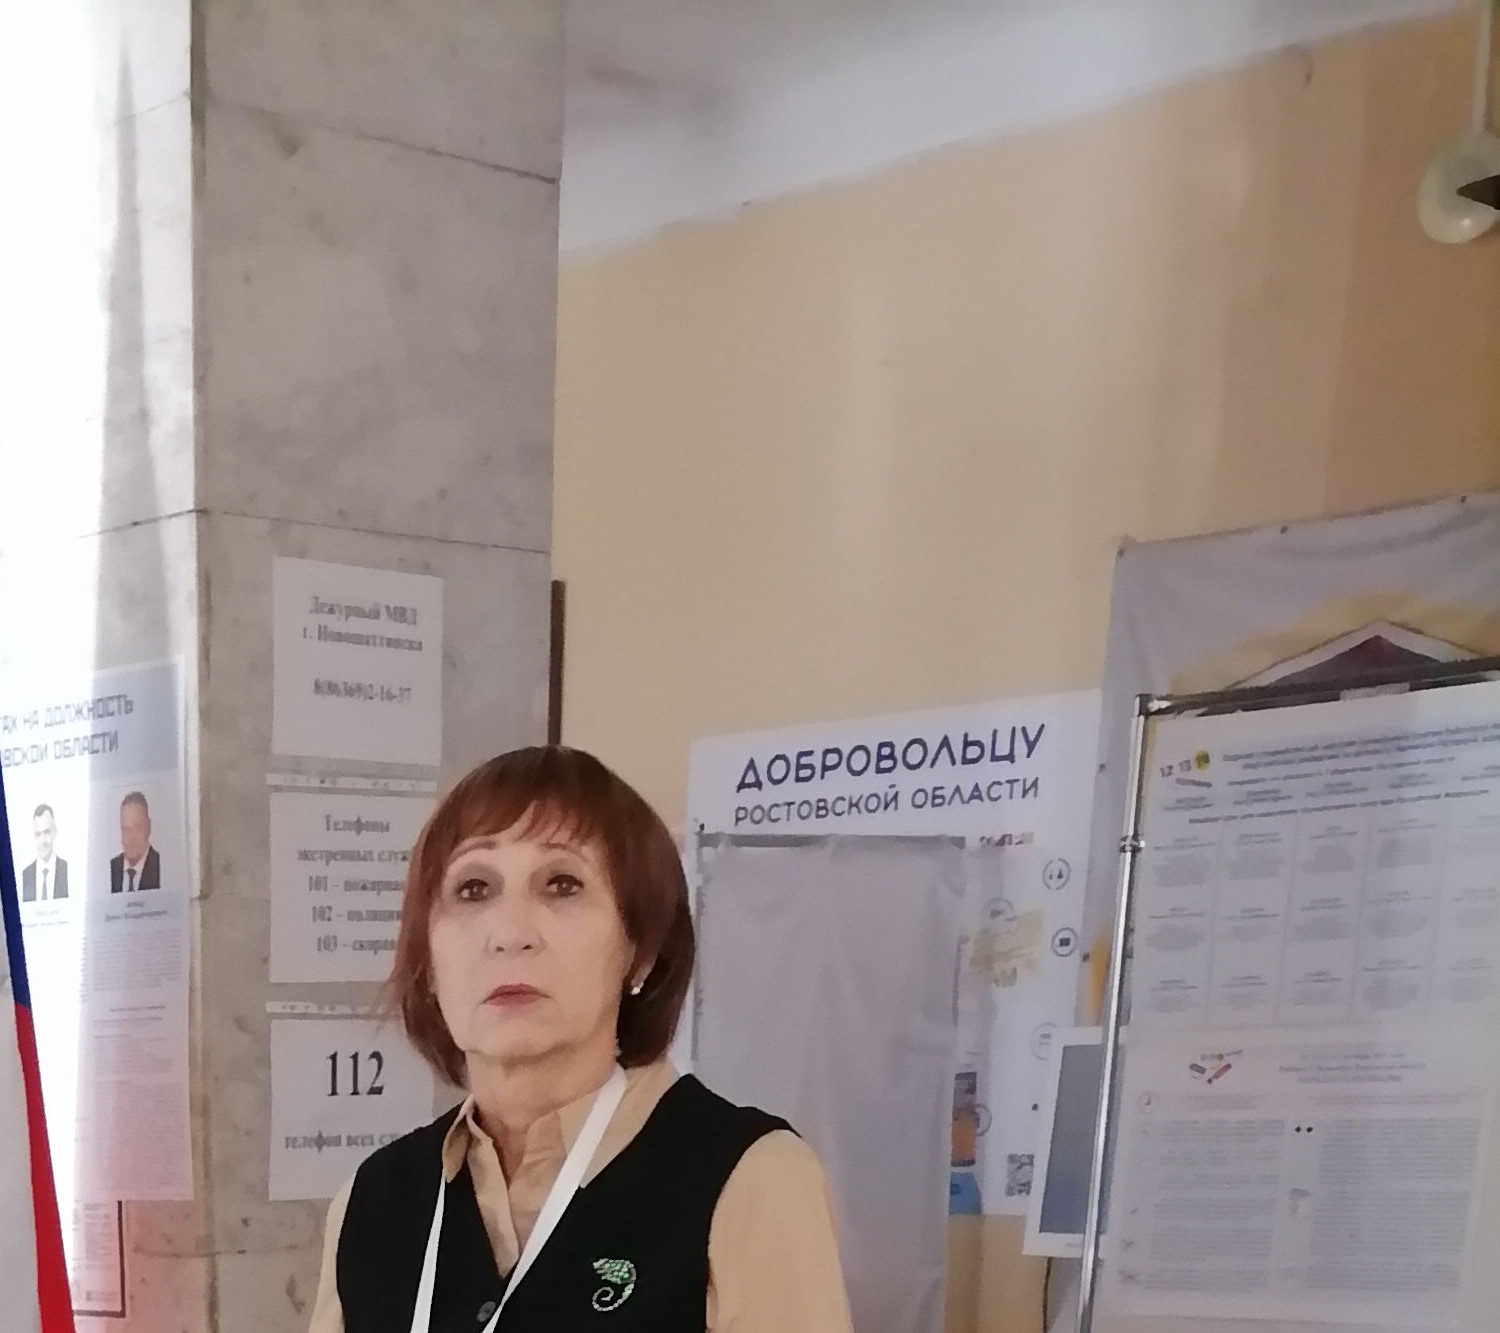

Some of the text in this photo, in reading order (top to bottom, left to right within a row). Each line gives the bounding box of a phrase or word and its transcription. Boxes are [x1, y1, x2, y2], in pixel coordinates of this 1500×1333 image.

[45, 693, 134, 728] ДОЛЖНОСТЬ
[53, 729, 119, 759] ОБЛАСТИ
[735, 723, 1045, 793] ДОБРОВОЛЬЦУ
[734, 777, 1040, 827] РОСТОВСКОЙ ОБЛАСТИ
[324, 814, 390, 836] Телефоны
[308, 875, 328, 892] 101
[312, 905, 333, 922] 102
[325, 1050, 385, 1096] 112
